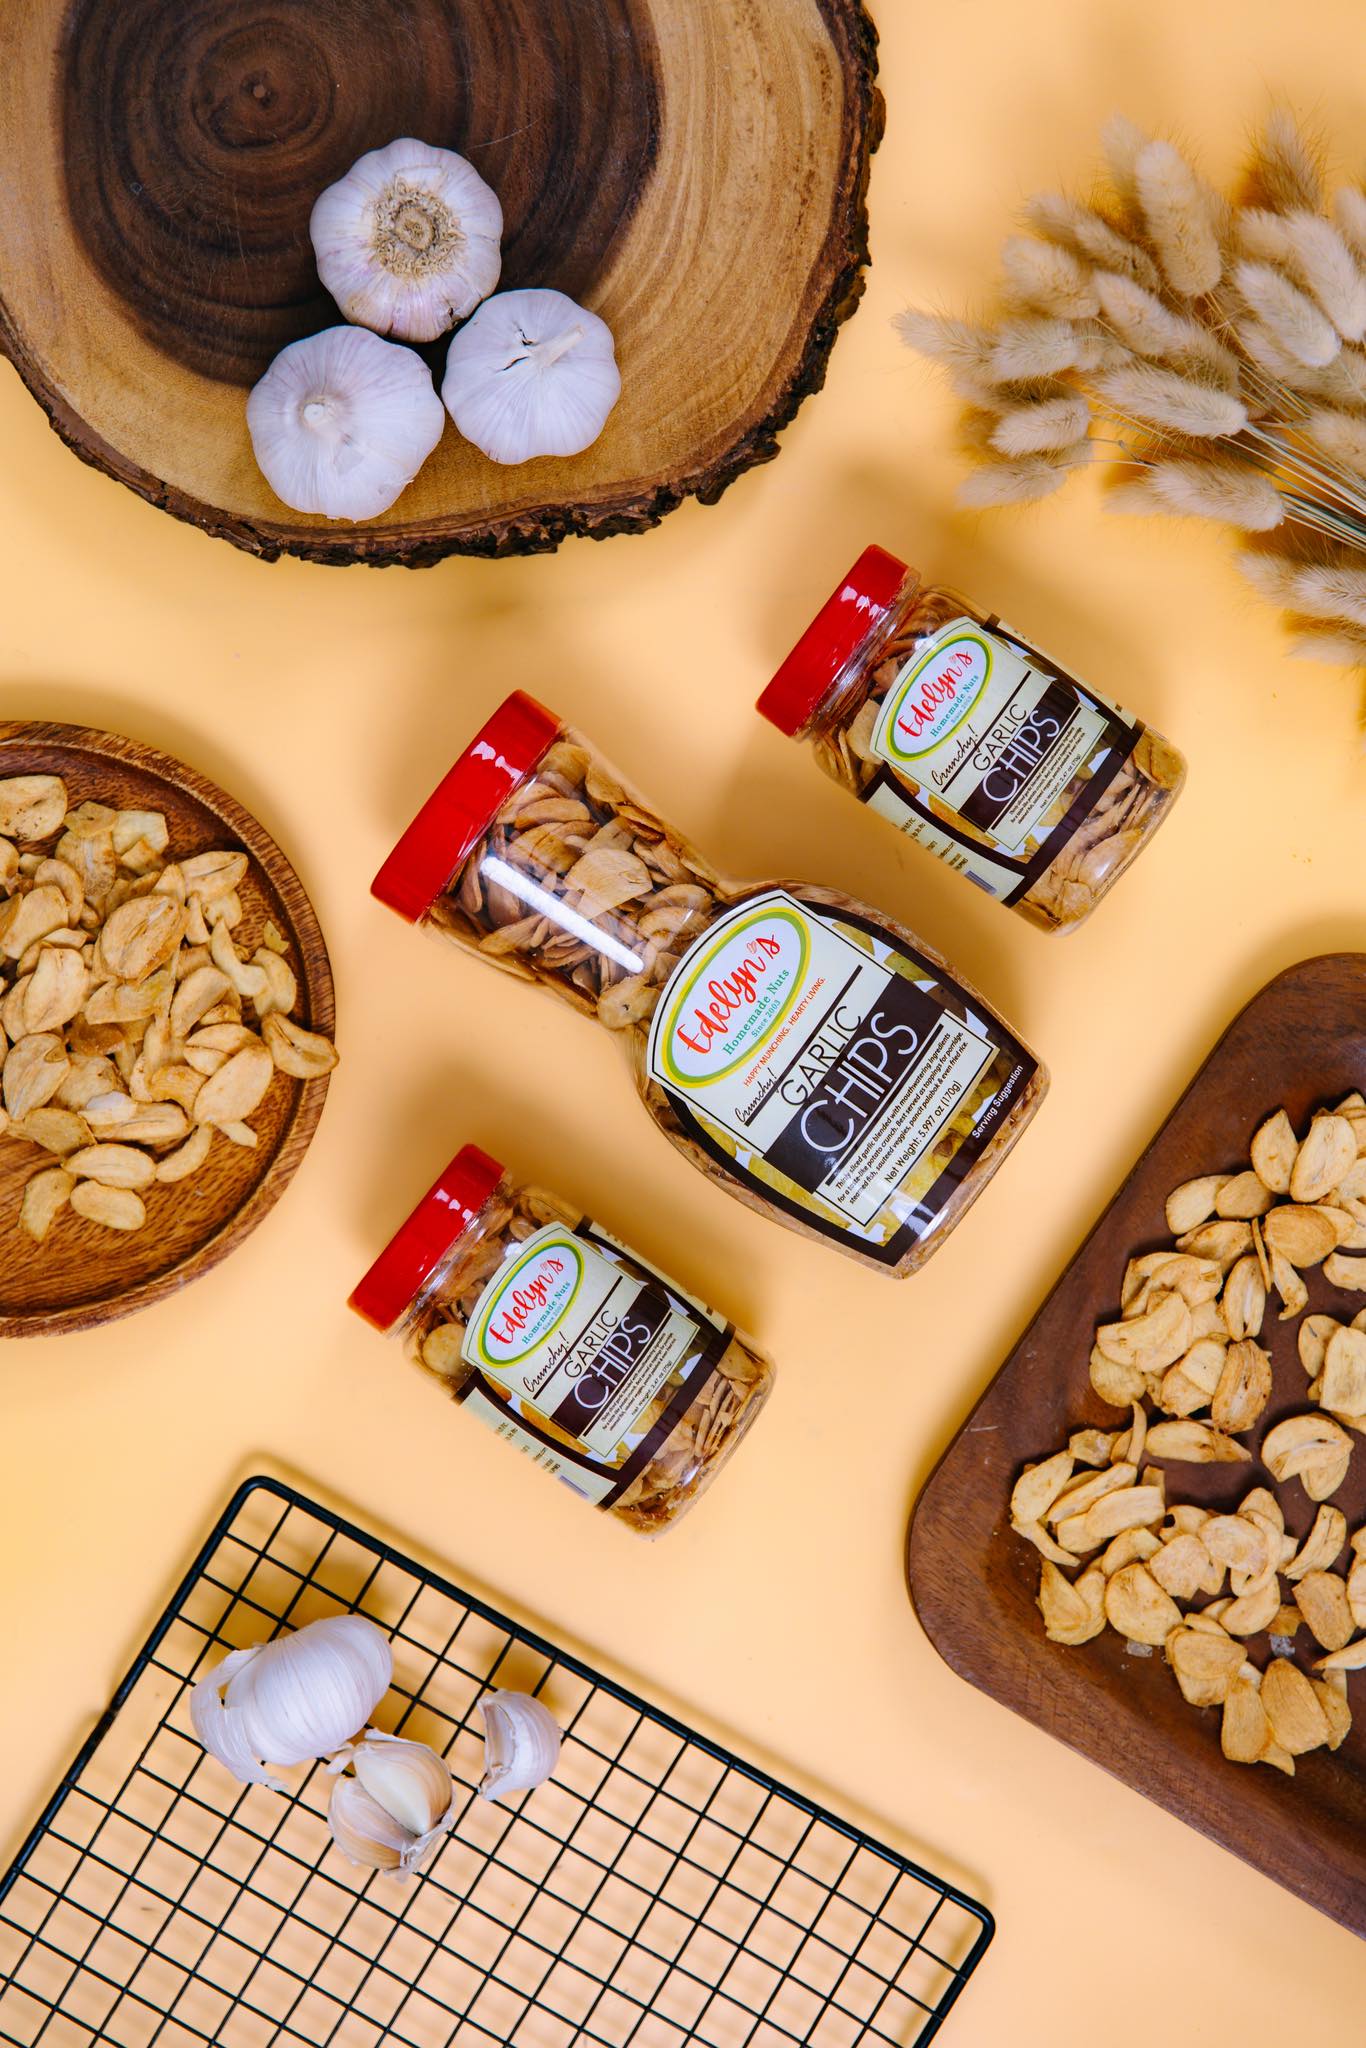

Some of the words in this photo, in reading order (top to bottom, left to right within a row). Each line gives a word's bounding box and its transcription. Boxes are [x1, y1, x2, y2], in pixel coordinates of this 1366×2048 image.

[897, 650, 973, 737] Edelyn's
[930, 694, 965, 737] Homemade
[963, 675, 978, 692] Nuts
[931, 724, 979, 786] Crunchy!
[973, 704, 1026, 771] GARLIC
[983, 711, 1061, 806] CHIPS
[676, 932, 781, 1054] Edelyn's
[723, 997, 770, 1054] Homemade
[766, 970, 789, 994] Nuts
[744, 1064, 761, 1086] HAPPY
[760, 1028, 790, 1065] MUNCHING.
[788, 999, 808, 1025] HEARTY
[807, 978, 824, 1000] LIVING.
[751, 1018, 768, 1037] Since
[764, 1000, 780, 1018] 2003
[735, 1067, 779, 1123] Crunchy!
[778, 1006, 861, 1105] GARLIC
[801, 1013, 917, 1162] CHIPS
[836, 1193, 846, 1203] for
[866, 1146, 884, 1168] potato
[880, 1126, 898, 1148] crunch.
[895, 1112, 907, 1127] Best
[904, 1093, 920, 1114] served
[922, 1062, 943, 1088] toppings
[938, 1054, 948, 1064] for
[848, 1155, 864, 1173] sliced
[860, 1140, 876, 1159] garlic
[872, 1116, 892, 1142] blended
[889, 1104, 902, 1119] with
[898, 1062, 932, 1106] mouthwatering
[927, 1032, 952, 1064] ingredients
[874, 1146, 894, 1171] sauteed
[940, 1064, 952, 1079] even
[949, 1050, 962, 1066] fried
[884, 1167, 899, 1183] Net
[896, 1138, 921, 1167] Weight:
[918, 1115, 935, 1137] 5.997
[941, 1080, 962, 1107] (170g)
[972, 1107, 998, 1138] Serving
[990, 1066, 1023, 1107] Suggestion
[489, 1257, 564, 1344] Edelyn's
[522, 1301, 556, 1344] Homemade
[554, 1283, 570, 1299] Nuts
[523, 1331, 570, 1393] Crunchy!
[564, 1311, 618, 1378] GARLIC
[574, 1317, 654, 1409] CHIPS
